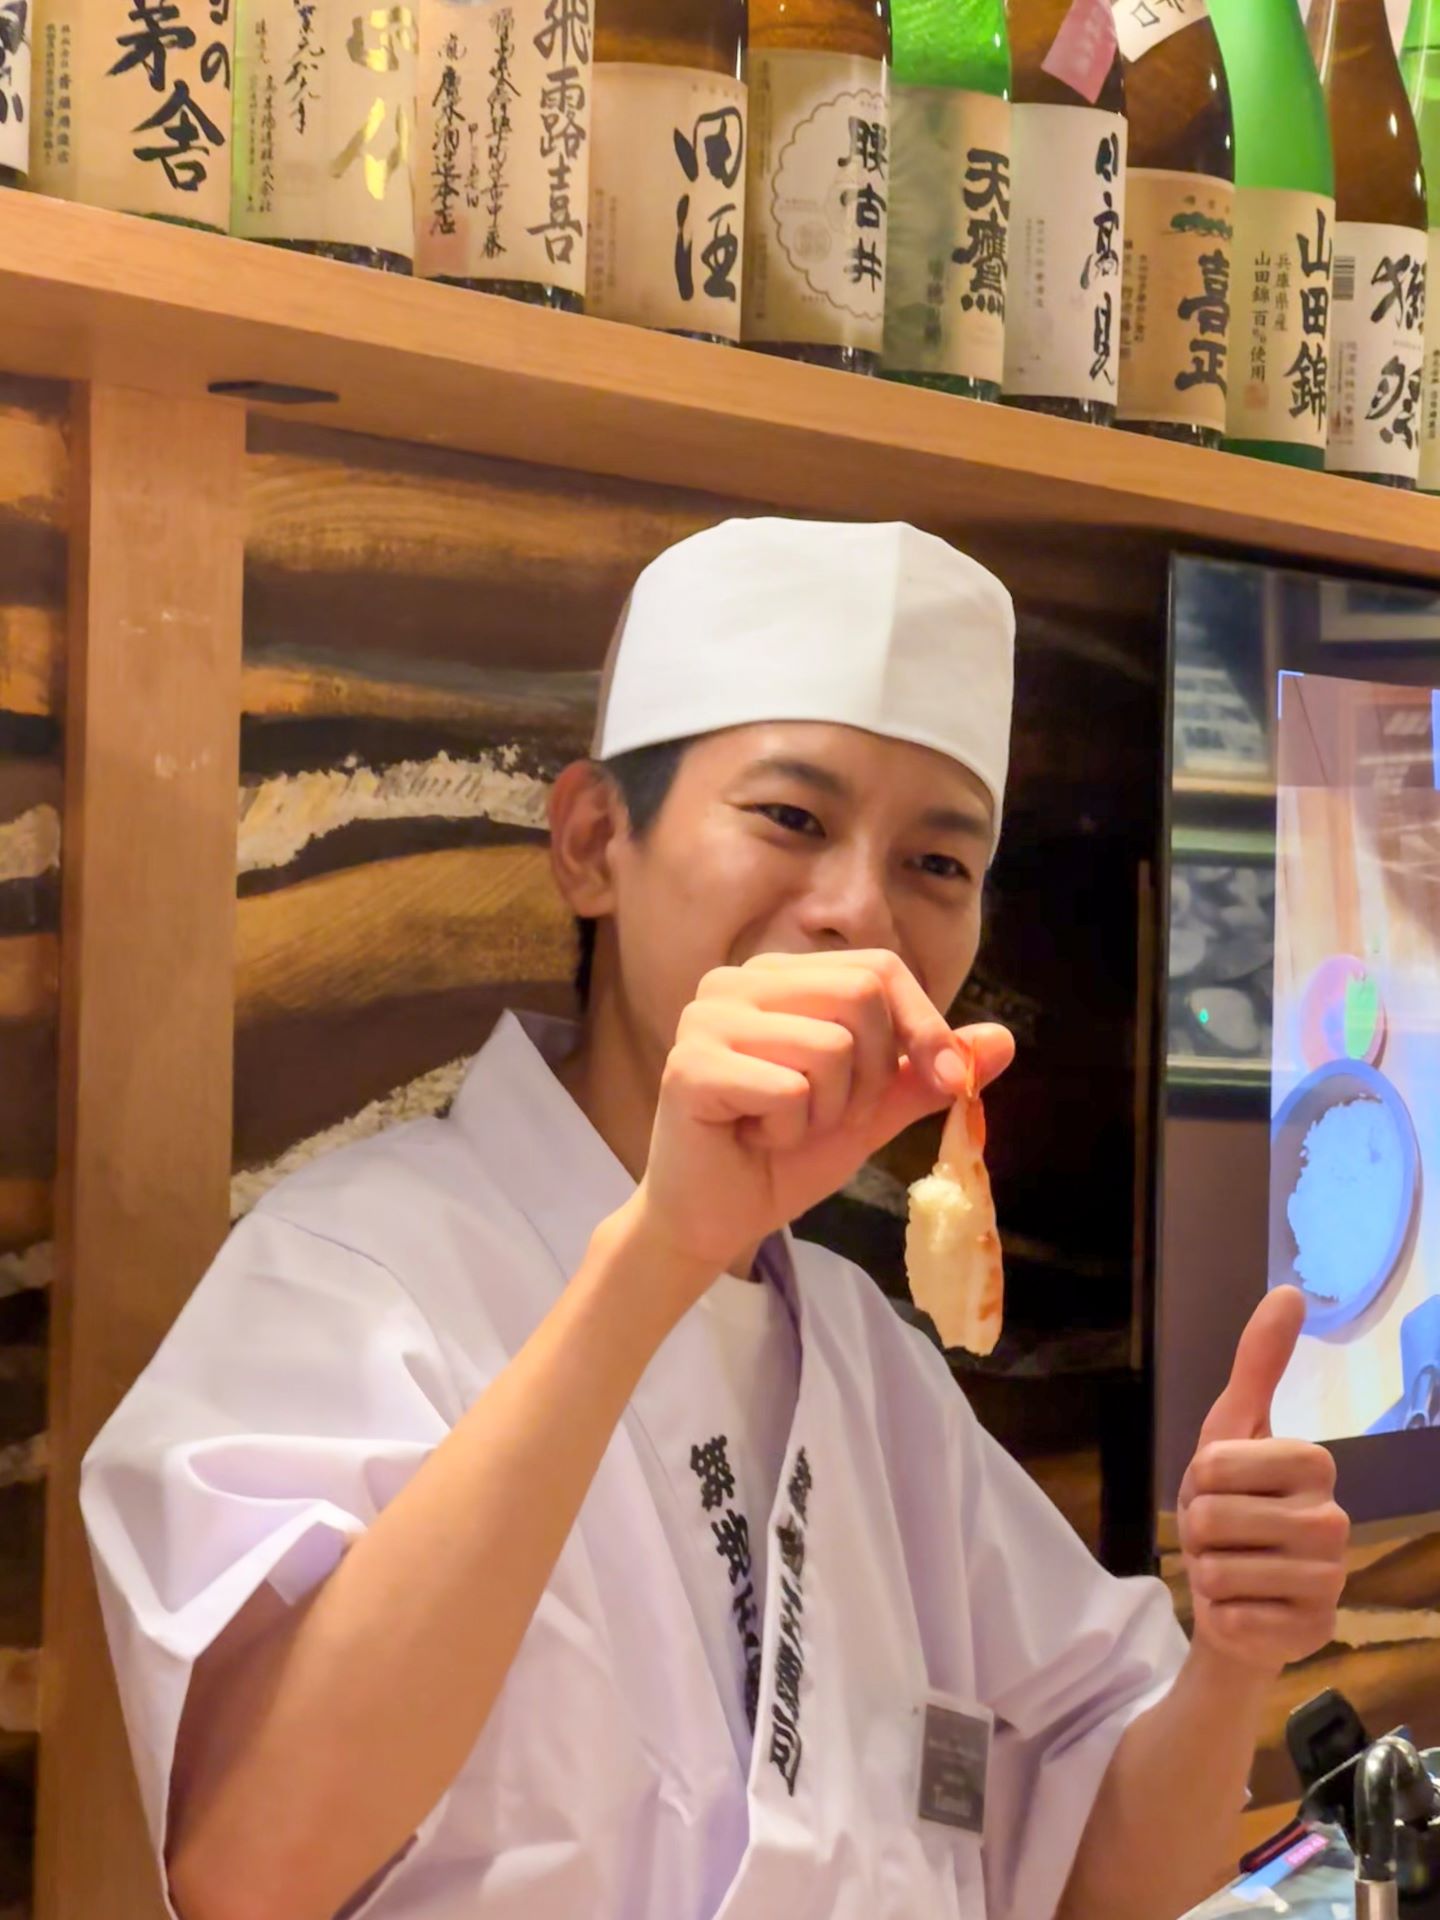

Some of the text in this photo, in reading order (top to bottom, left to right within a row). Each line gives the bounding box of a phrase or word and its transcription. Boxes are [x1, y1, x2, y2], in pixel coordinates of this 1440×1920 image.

[106, 0, 226, 191] 茅舎
[527, 0, 590, 264] 飛露喜
[674, 106, 744, 303] 田酒
[951, 148, 1011, 320] 天鷹
[1273, 254, 1291, 332] 兵庫県産
[1175, 248, 1231, 396] 喜正
[1284, 207, 1333, 432] 山田錦
